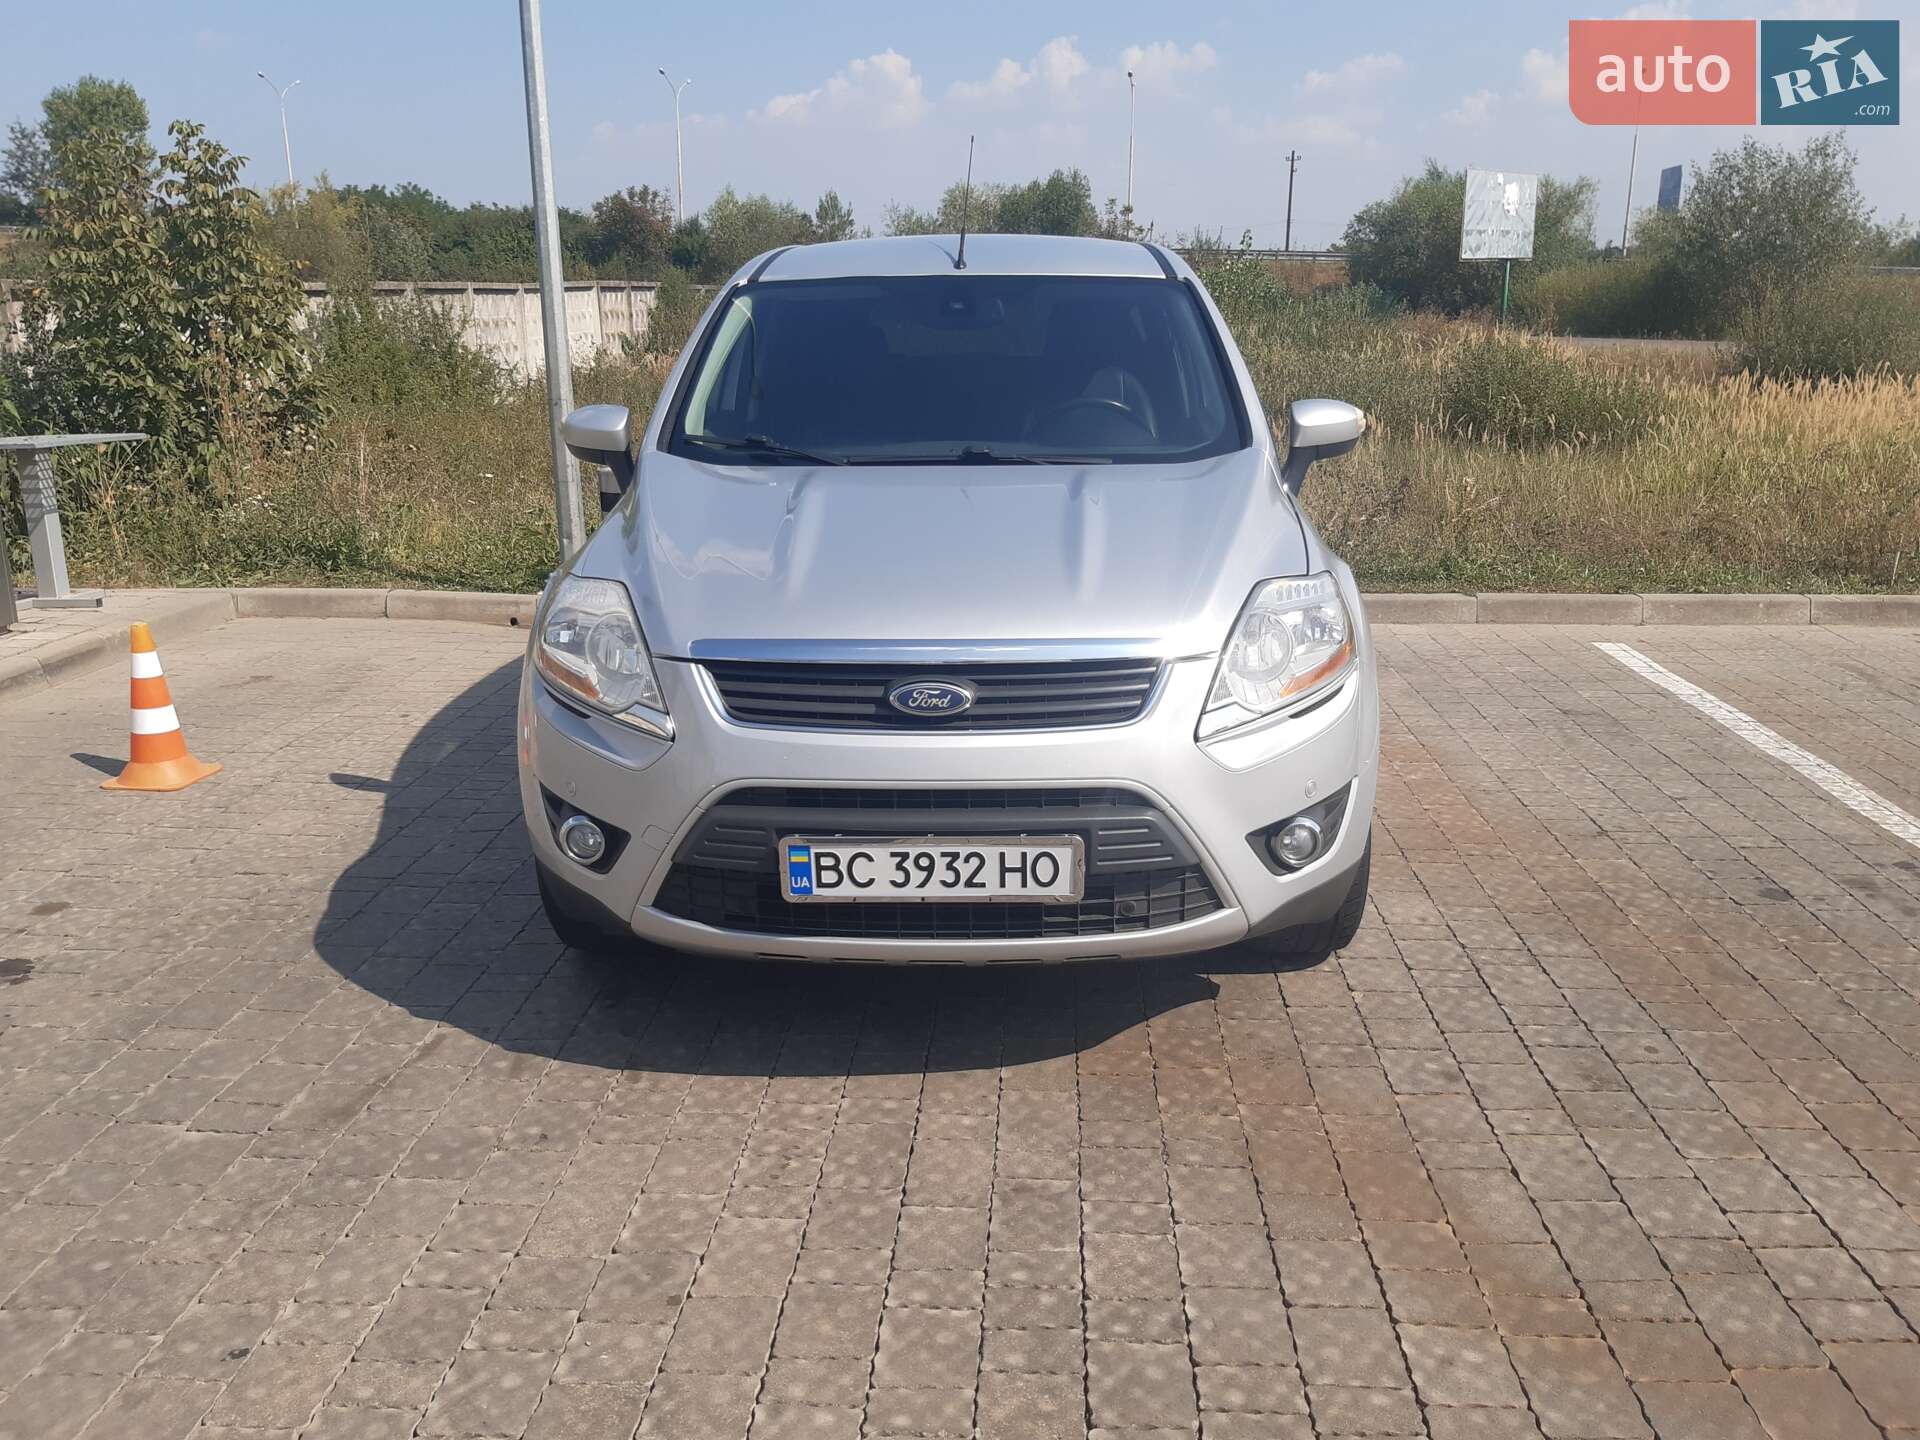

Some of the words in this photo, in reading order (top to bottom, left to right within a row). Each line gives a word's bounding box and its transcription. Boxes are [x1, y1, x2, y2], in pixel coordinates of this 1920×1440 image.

[908, 689, 952, 708] Ford
[814, 851, 876, 889] BC
[889, 851, 987, 889] 3932
[999, 851, 1060, 889] HO
[791, 876, 811, 889] UA
